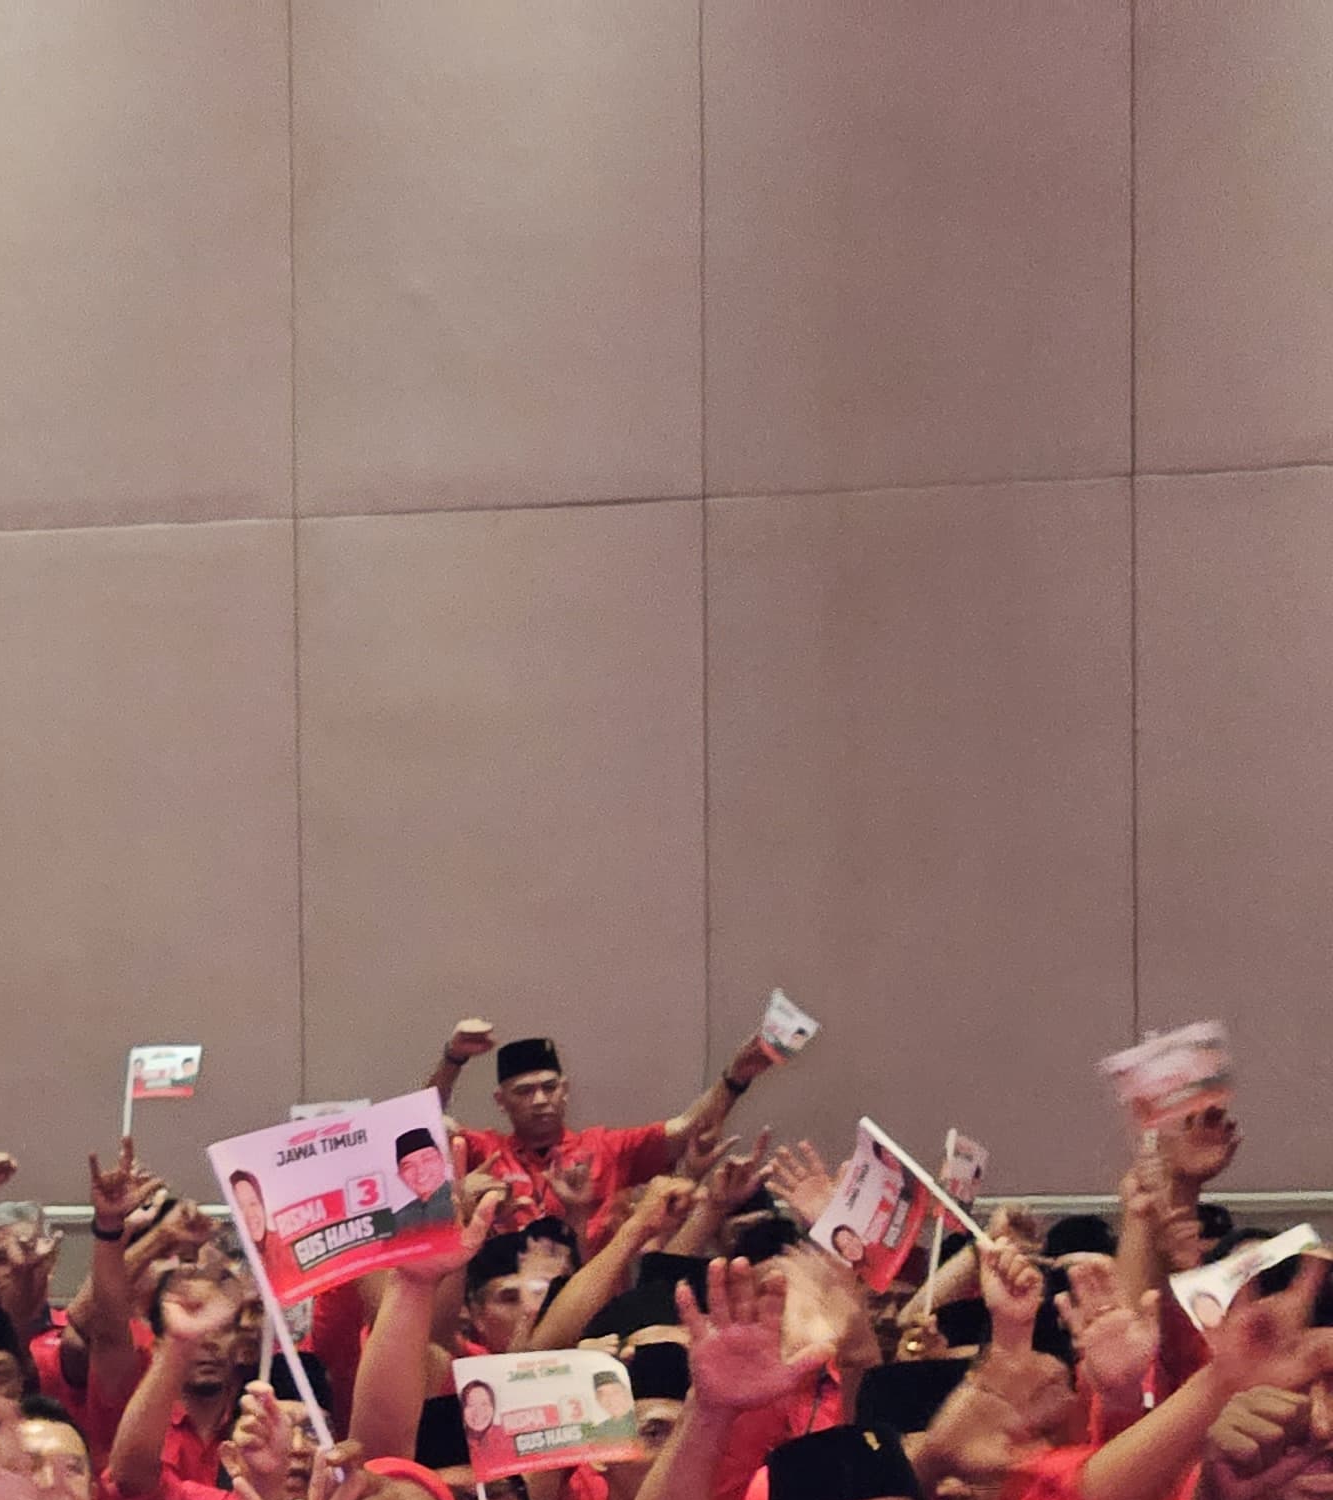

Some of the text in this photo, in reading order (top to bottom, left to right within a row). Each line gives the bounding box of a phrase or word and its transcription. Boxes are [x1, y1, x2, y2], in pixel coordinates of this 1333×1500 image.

[276, 1143, 319, 1167] JAWA
[321, 1129, 368, 1154] TIMUR
[355, 1178, 380, 1207] 3
[325, 1216, 375, 1249] HANS
